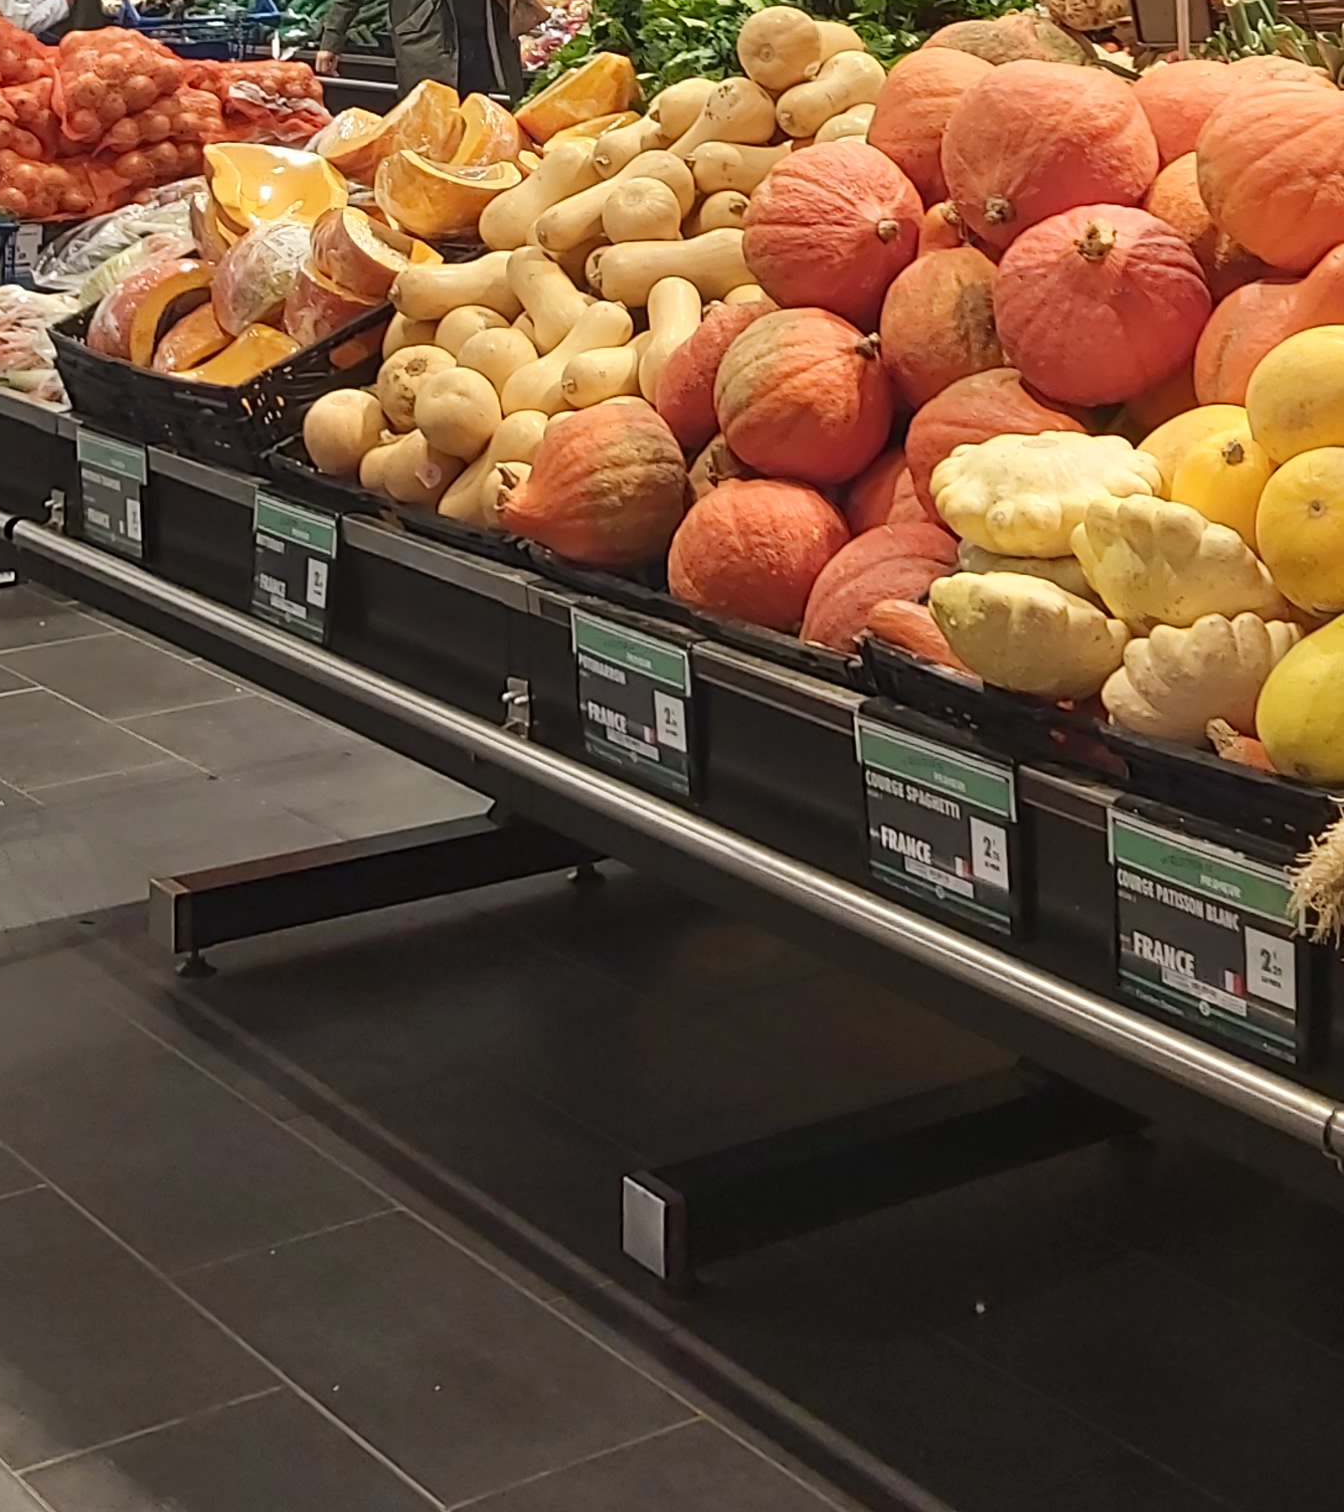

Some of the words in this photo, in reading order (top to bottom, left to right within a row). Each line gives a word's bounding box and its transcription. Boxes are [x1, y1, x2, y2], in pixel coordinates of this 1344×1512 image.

[587, 700, 628, 734] FRANCE
[865, 769, 904, 798] COURGE
[906, 784, 960, 820] SPAGHETTI
[880, 825, 932, 865] FRANCE
[1117, 868, 1154, 898] COURGE
[1205, 903, 1240, 932] BLANC
[1133, 931, 1195, 977] FRANCE
